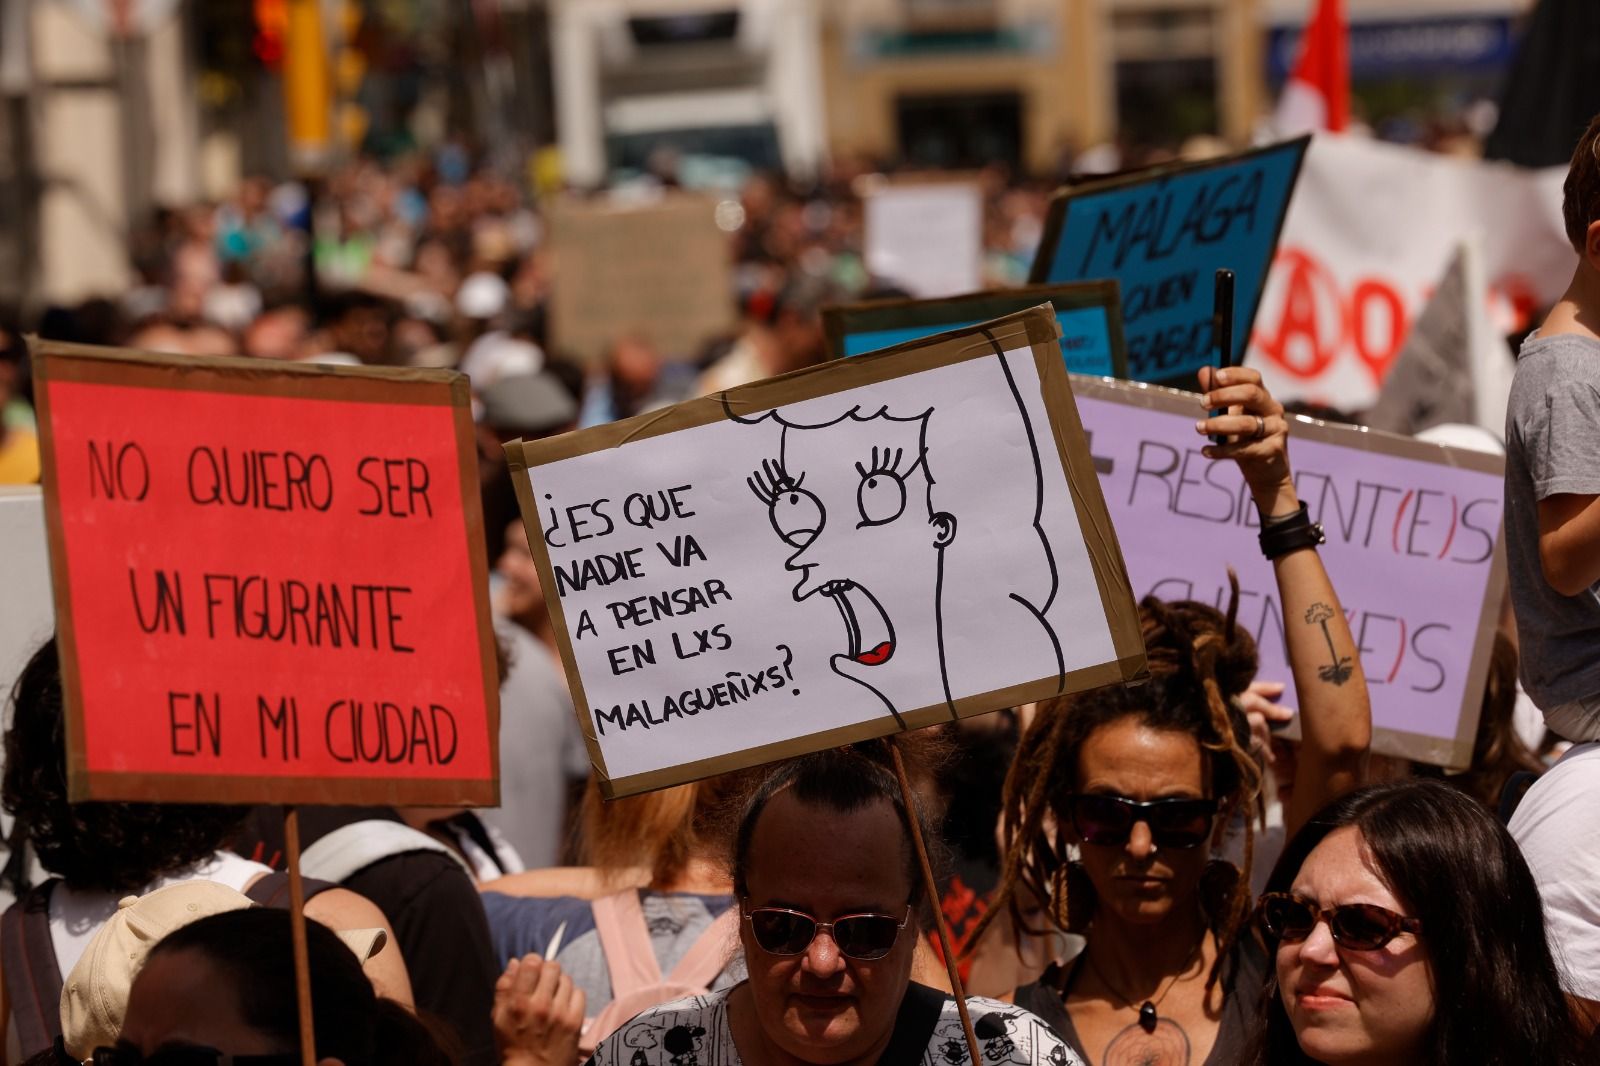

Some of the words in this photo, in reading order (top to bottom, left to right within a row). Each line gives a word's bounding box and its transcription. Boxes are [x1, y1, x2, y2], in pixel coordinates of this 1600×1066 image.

[89, 442, 149, 501] NO
[188, 447, 332, 512] QUIERO
[357, 457, 432, 518] SER
[544, 493, 615, 548] ¿ES
[624, 485, 695, 529] QUE
[553, 547, 646, 597] NADIE
[656, 535, 707, 567] VA
[130, 570, 186, 635] UN
[204, 575, 414, 653] FIGURANTE
[575, 609, 599, 640] A
[605, 579, 733, 630] PENSAR
[607, 639, 656, 675] EN
[169, 692, 221, 757] EN
[258, 696, 299, 761] MI
[325, 700, 457, 765] CIUDAD
